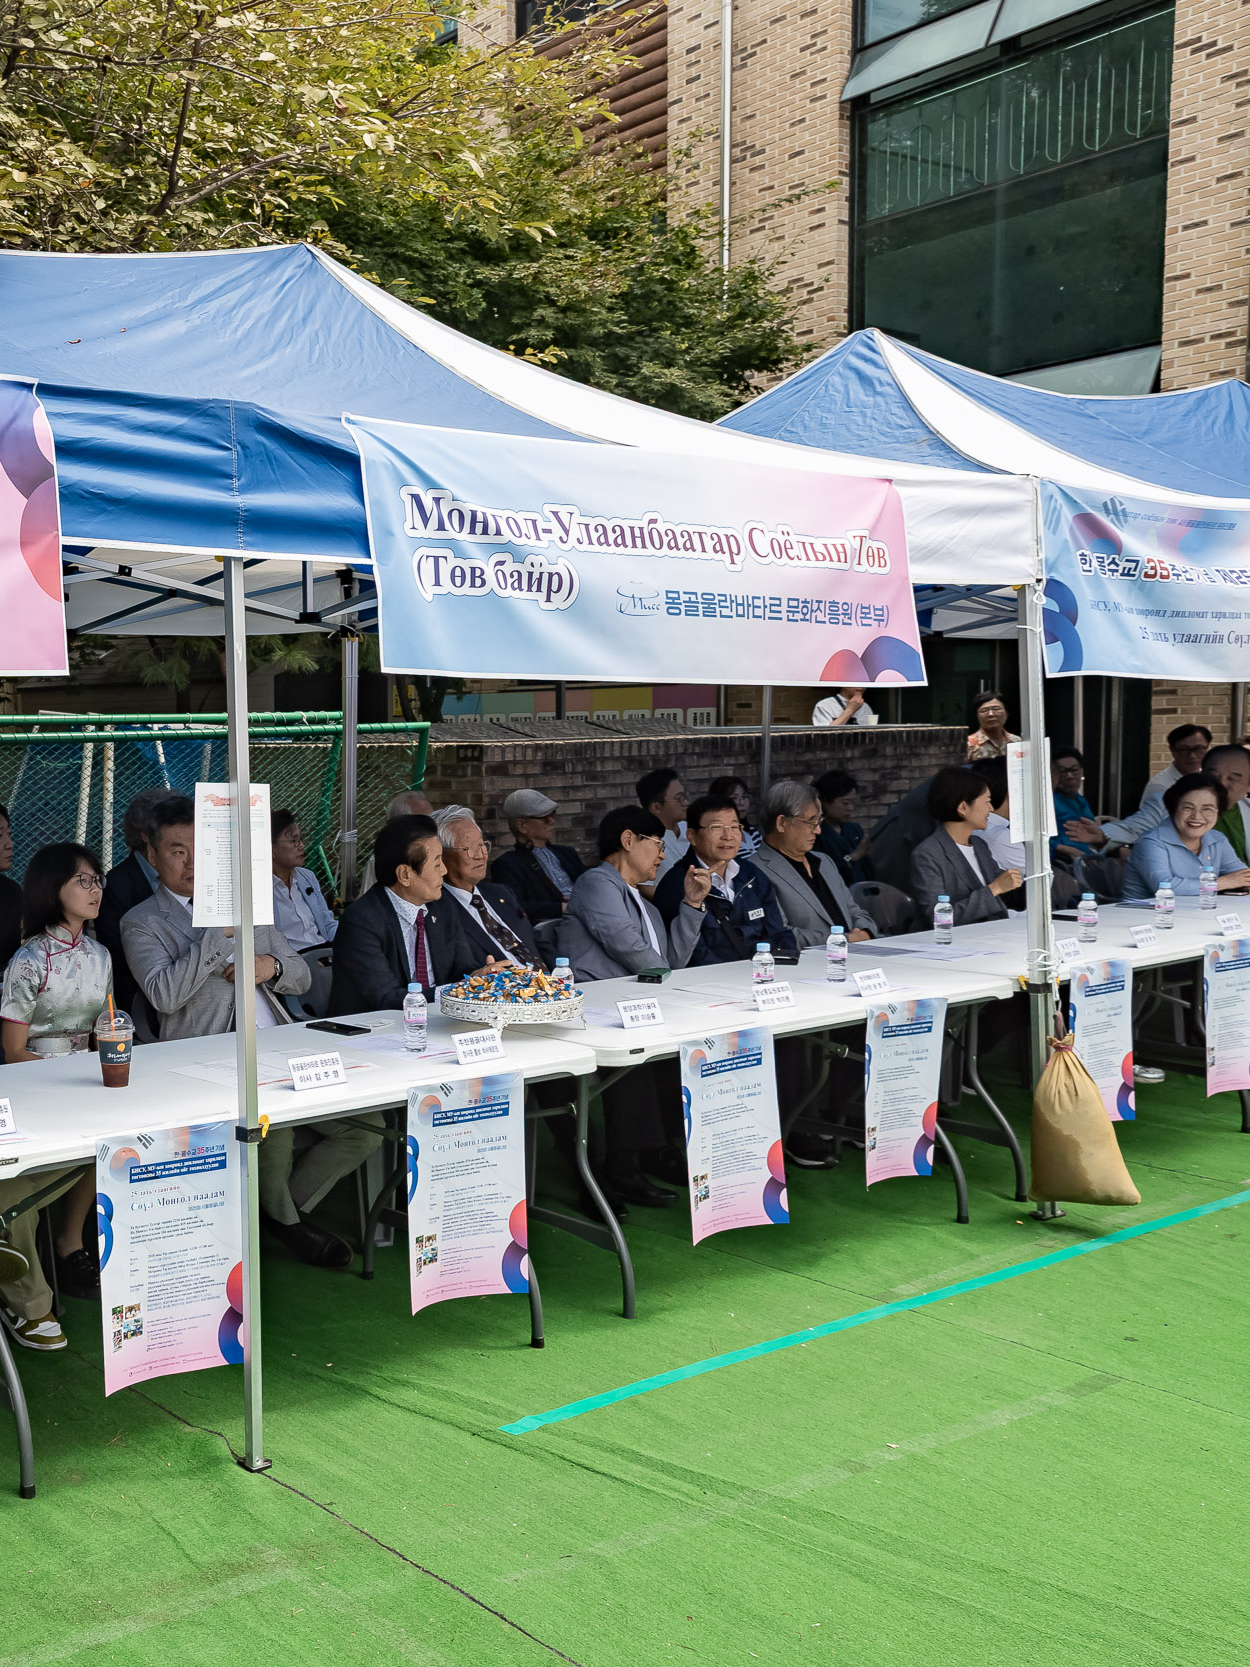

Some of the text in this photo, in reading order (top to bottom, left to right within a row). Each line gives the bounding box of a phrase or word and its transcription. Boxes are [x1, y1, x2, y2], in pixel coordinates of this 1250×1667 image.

[407, 492, 887, 569] Монгол-Улаанбаатар Соёлын Төв
[416, 550, 575, 602] (Төв байр)
[665, 589, 782, 621] 몽골울란바타르
[1172, 630, 1224, 646] удаагийн
